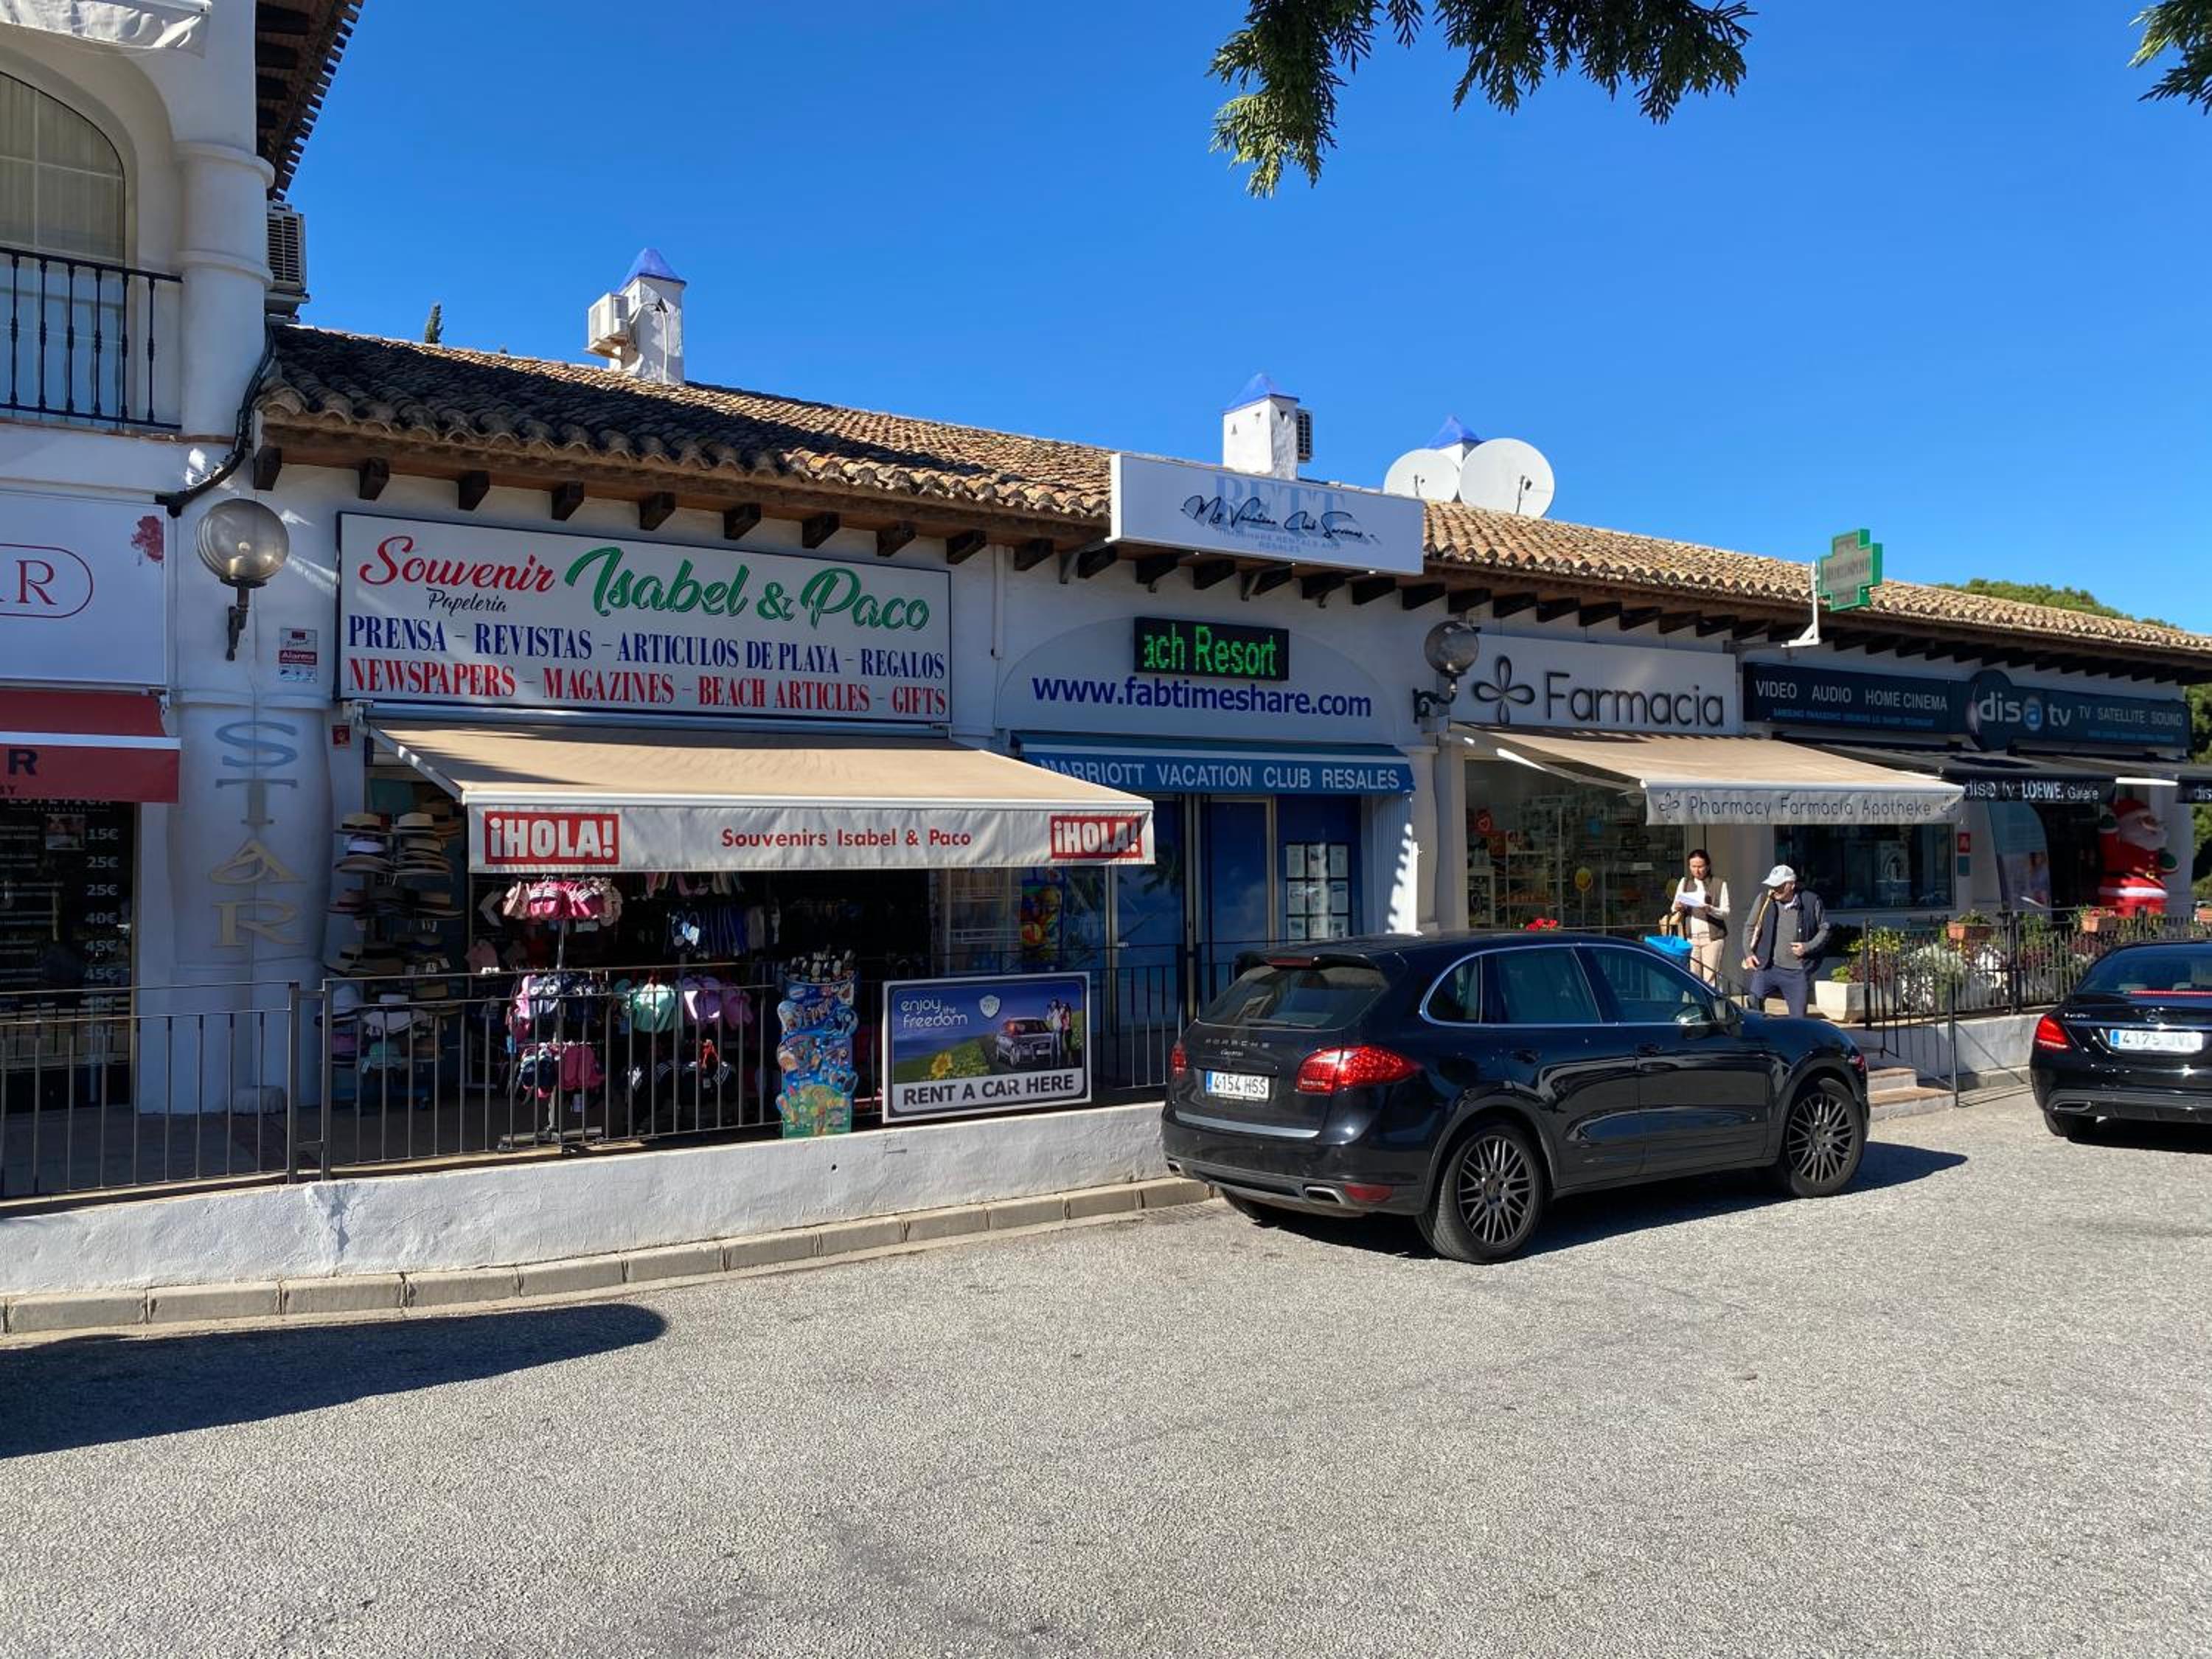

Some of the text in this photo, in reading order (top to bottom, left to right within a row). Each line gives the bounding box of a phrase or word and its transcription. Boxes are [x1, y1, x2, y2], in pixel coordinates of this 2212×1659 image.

[358, 535, 555, 592] Souvenir
[564, 546, 930, 631] Isabel & Paco
[425, 587, 508, 616] Papeleria
[349, 615, 447, 652] PRENSA
[475, 622, 592, 660] REVISTAS
[617, 632, 738, 668] ARTICULOS
[747, 640, 773, 670] DE
[779, 642, 839, 674] PLAYA
[860, 648, 945, 679] REGALOS
[1194, 626, 1277, 676] Resort
[349, 658, 515, 697] NEWSPAPERS
[543, 667, 675, 703] MAGAZINES
[698, 675, 765, 708] BEACH
[774, 679, 870, 712] ARTICLES
[891, 685, 945, 716] GIFTS
[1032, 675, 1371, 717] www.fabtimeshare.com
[1545, 671, 1724, 728] Farmacia
[1755, 680, 1947, 711] VIDEO AUDIO HOME CINEMA
[2048, 703, 2071, 727] tv
[2078, 706, 2183, 726] TV SATELLITE SOUND
[1156, 764, 1251, 787] VACATION
[1263, 767, 1311, 789] CLUB
[1322, 768, 1399, 790] RESALES
[1690, 796, 1932, 818] Pharmacy Farmacia Apotheke
[87, 827, 119, 840] 15€
[489, 816, 614, 858] ¡HOLA!
[721, 827, 972, 847] Souvenirs Isabel & Paco
[1054, 820, 1141, 854] ¡HOLA!
[86, 856, 119, 868] 25€
[86, 884, 118, 896] 25€
[85, 912, 118, 924] 40€
[85, 940, 118, 952] 45€
[900, 998, 942, 1015] enjoy
[942, 1005, 957, 1015] the
[903, 1013, 968, 1029] freedom
[903, 1074, 1074, 1105] RENT A CAR HERE
[1214, 1075, 1267, 1095] 4154 HSS
